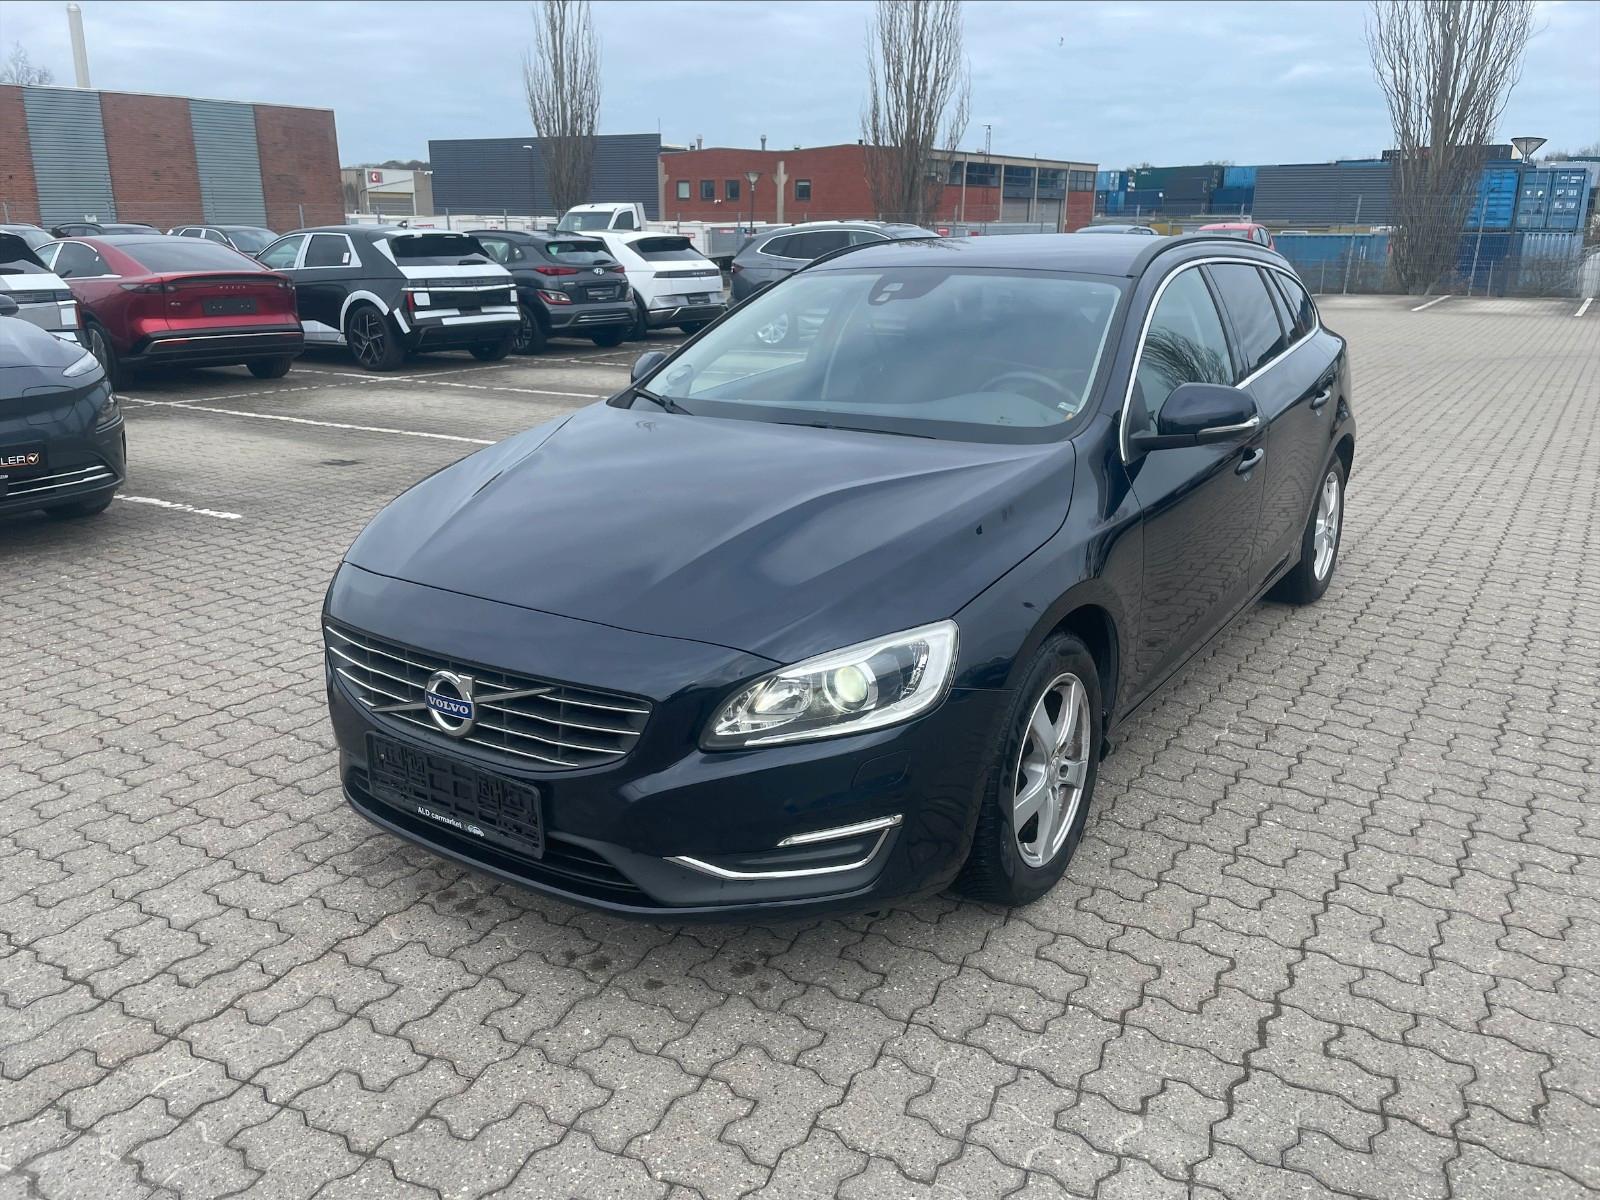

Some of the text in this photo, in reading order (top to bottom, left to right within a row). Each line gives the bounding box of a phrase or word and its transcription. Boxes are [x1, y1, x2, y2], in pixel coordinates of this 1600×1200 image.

[427, 695, 469, 715] VOLVO
[417, 806, 463, 829] ALD carmarket
